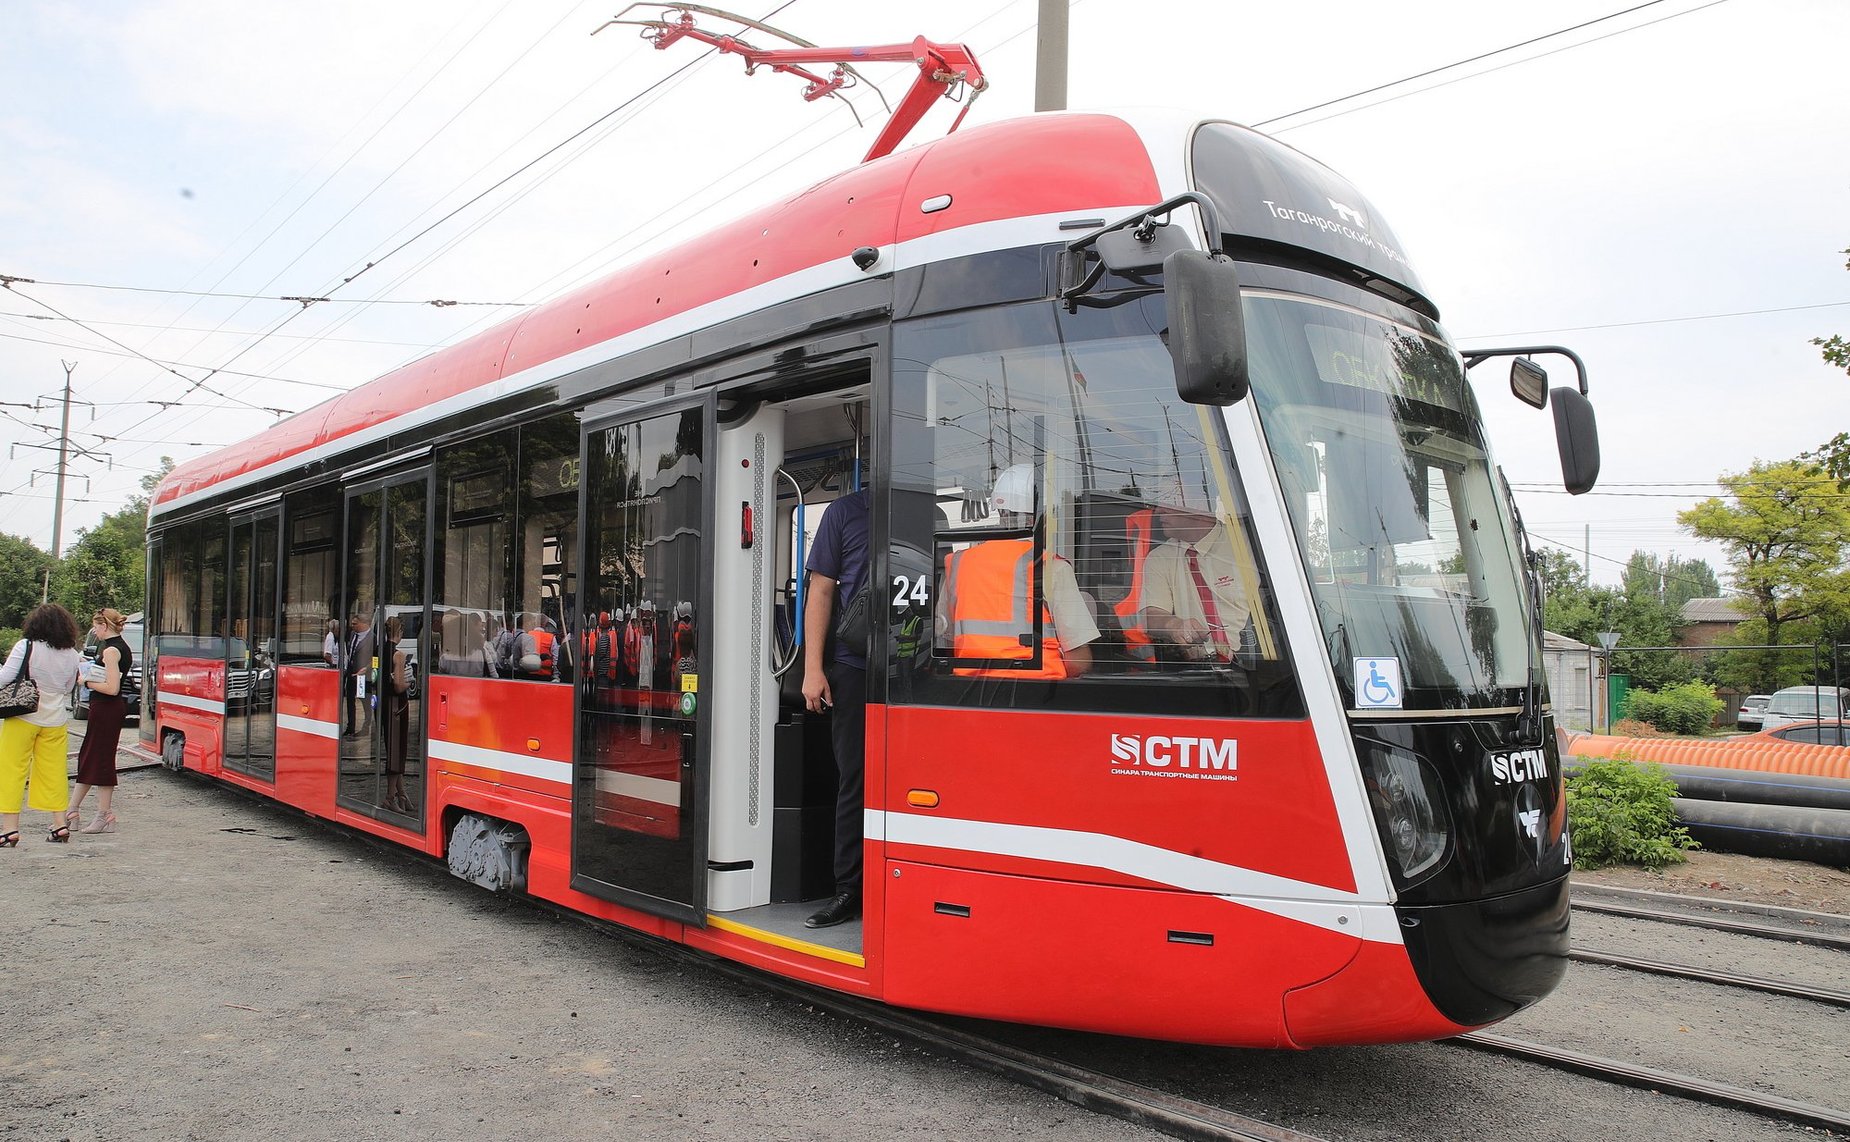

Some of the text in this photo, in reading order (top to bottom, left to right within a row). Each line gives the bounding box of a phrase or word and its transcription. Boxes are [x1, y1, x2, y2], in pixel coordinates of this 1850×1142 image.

[1262, 199, 1376, 250] Таганрогский
[893, 575, 928, 606] 24
[1145, 735, 1238, 771] СТМ
[1509, 749, 1548, 783] СТМ
[1111, 768, 1238, 782] СИНАРА ТРАНСПОРТНЫЕ МАШИНЫ
